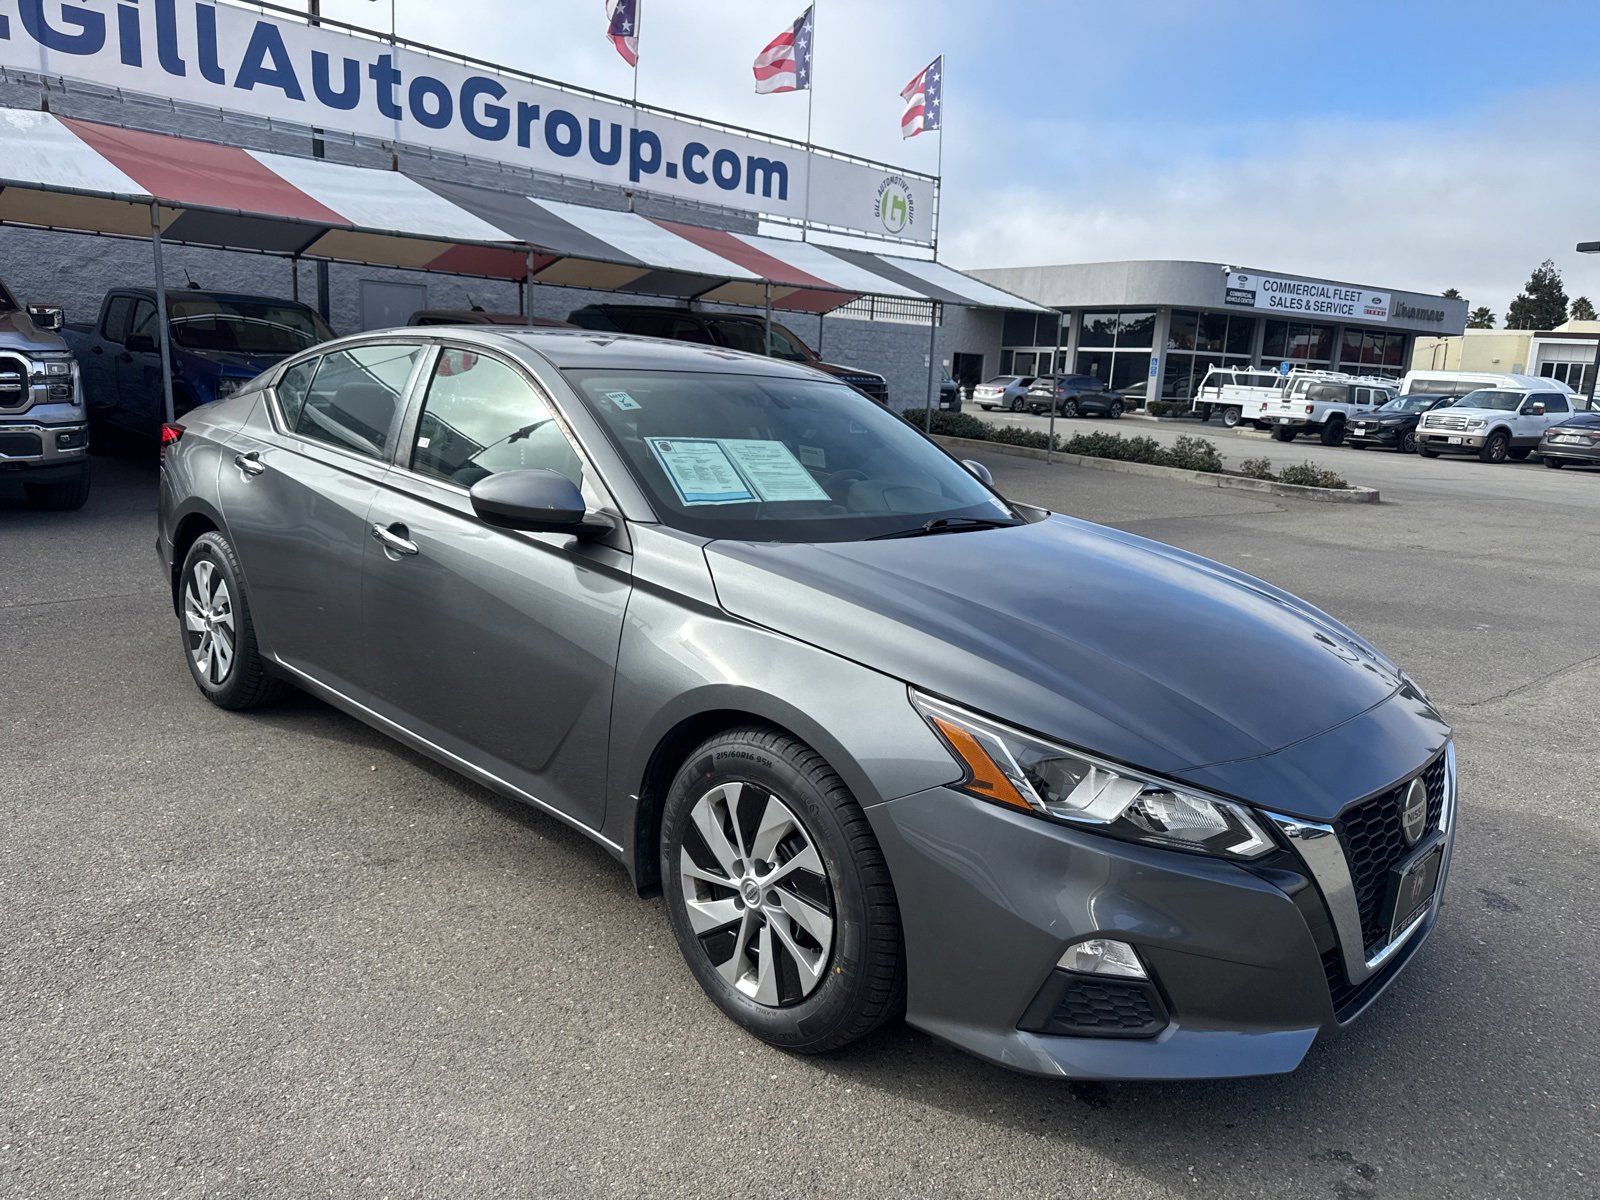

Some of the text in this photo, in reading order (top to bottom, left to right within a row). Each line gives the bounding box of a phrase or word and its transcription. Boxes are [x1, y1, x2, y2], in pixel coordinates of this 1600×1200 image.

[878, 176, 909, 197] AUTOMOTIVE
[906, 193, 914, 225] GROUP
[1263, 280, 1362, 303] COMMERCIAL FLEET
[1269, 295, 1354, 315] SALES & SERVICE
[716, 751, 773, 768] 215/60R16 95H
[1407, 803, 1424, 823] NISS
